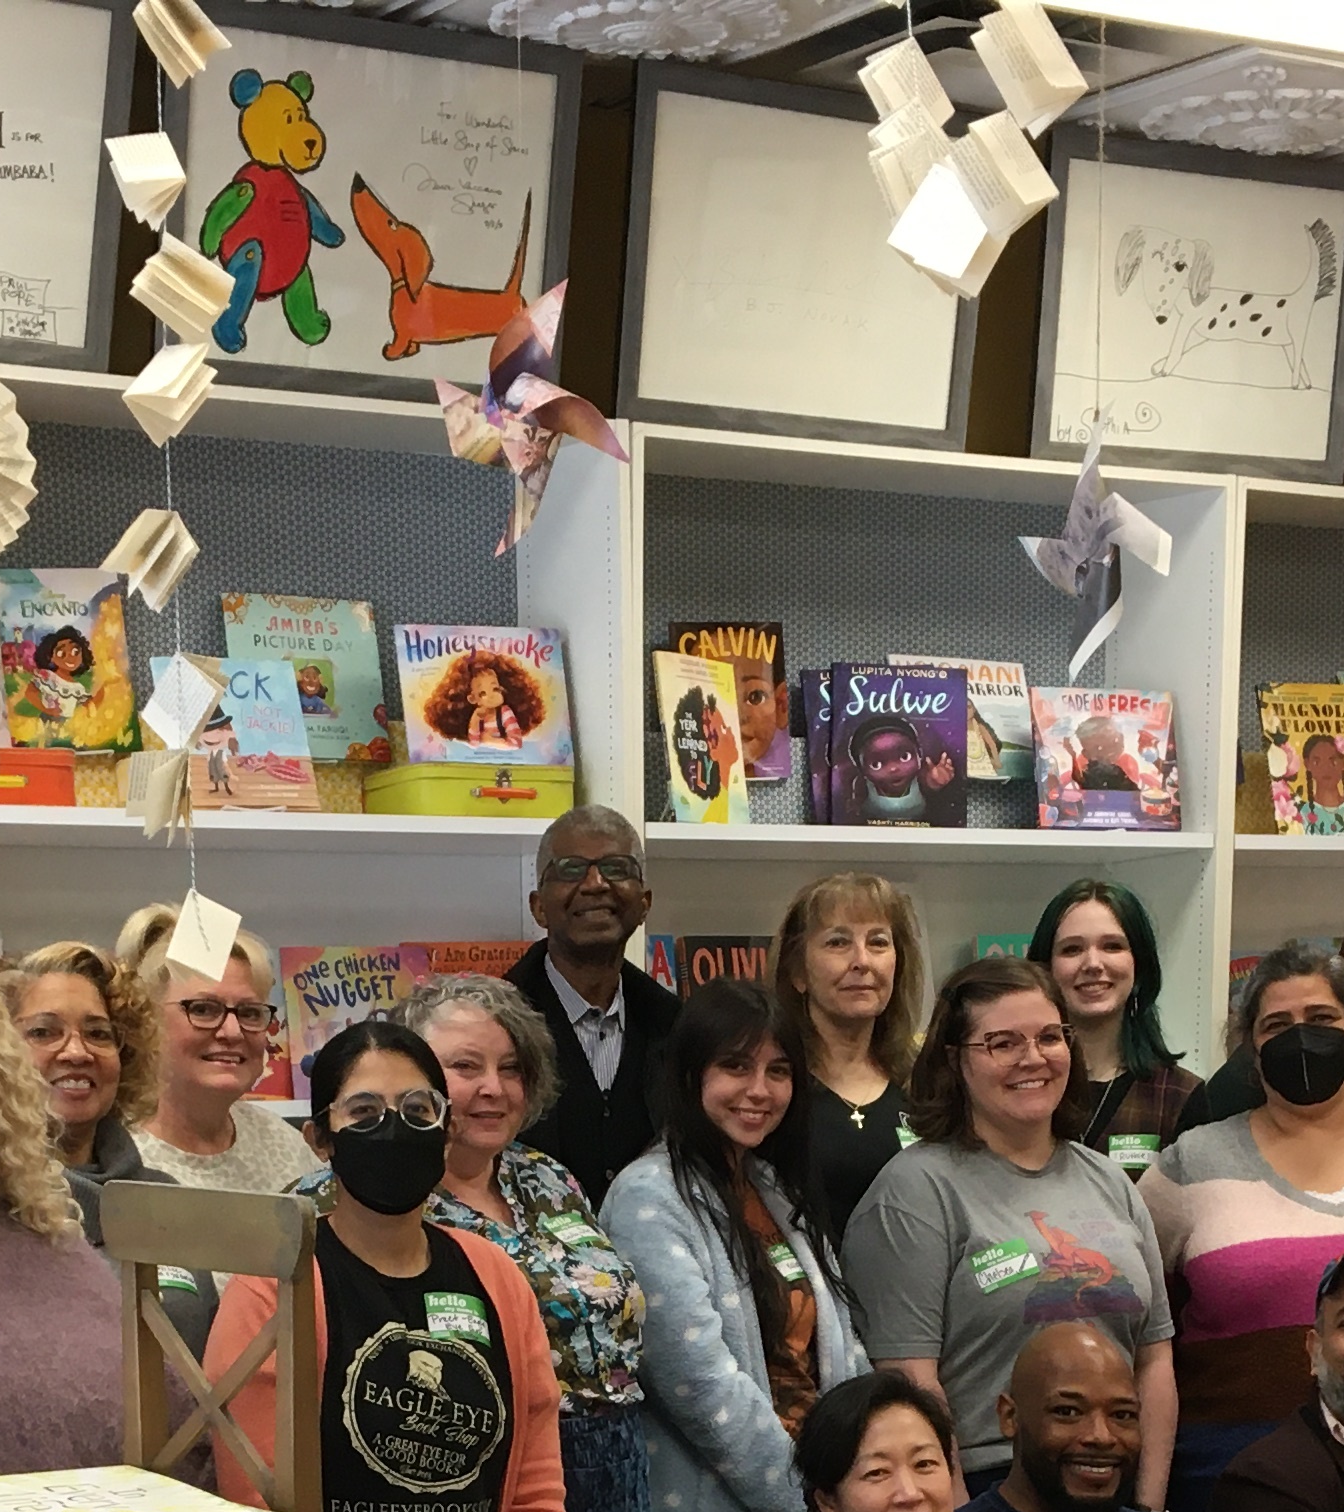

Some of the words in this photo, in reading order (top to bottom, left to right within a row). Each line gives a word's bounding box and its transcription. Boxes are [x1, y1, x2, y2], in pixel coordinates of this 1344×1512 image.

[19, 599, 90, 619] ENCANTO
[265, 615, 340, 636] AMIRA'S
[253, 633, 316, 651] PICTURE
[403, 628, 555, 669] Honeysmoke
[678, 625, 778, 664] CALVIN
[851, 666, 893, 678] LUPITA
[845, 675, 955, 717] Sulwe
[302, 974, 396, 1018] NUGGET
[1110, 1136, 1142, 1147] hello
[971, 1246, 1004, 1266] hello
[428, 1293, 467, 1309] hello
[363, 1379, 445, 1420] EAGLE
[451, 1401, 495, 1434] EYE
[399, 1413, 448, 1438] Book
[444, 1425, 481, 1450] Shop
[374, 1445, 417, 1465] GOOD
[419, 1457, 461, 1477] BOOKS
[385, 1435, 422, 1453] GREAT
[423, 1444, 443, 1460] EYE
[444, 1449, 468, 1467] FOR
